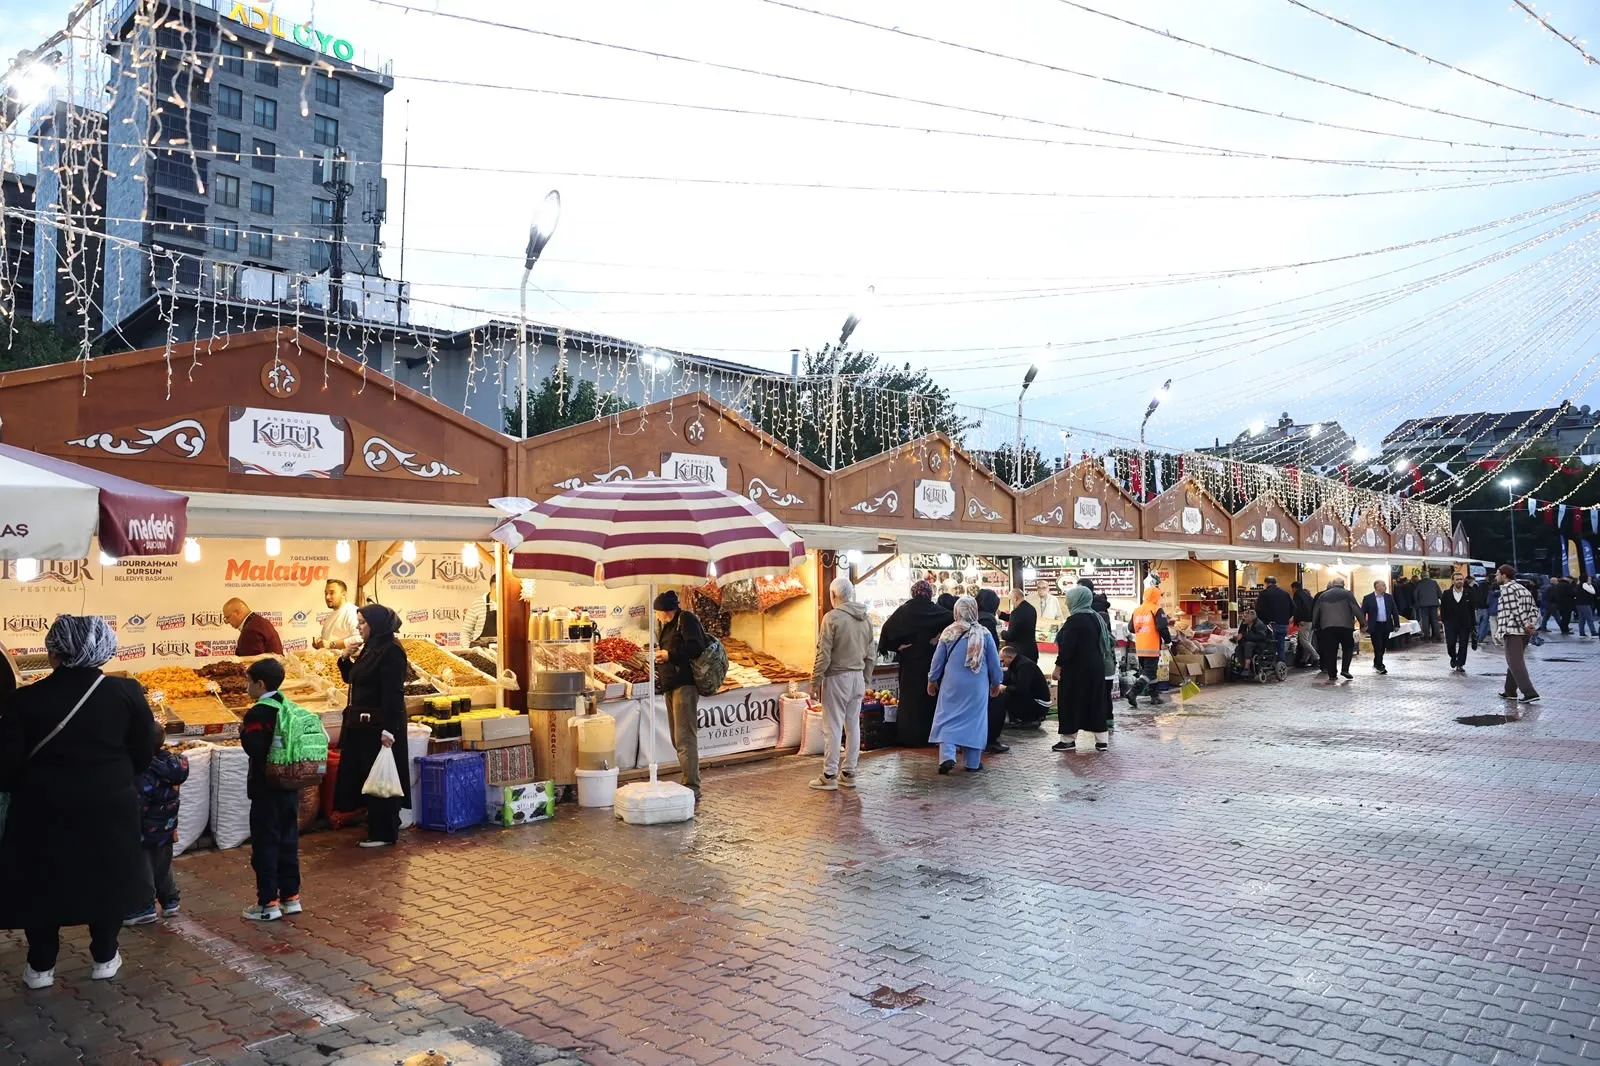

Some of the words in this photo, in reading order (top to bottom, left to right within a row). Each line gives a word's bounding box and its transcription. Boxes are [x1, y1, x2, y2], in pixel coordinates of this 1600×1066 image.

[293, 24, 353, 61] GYO
[252, 419, 324, 449] KÜLTÜR
[267, 416, 311, 424] ANADOLU
[225, 559, 330, 587] Malatya
[708, 725, 751, 740] YÖRESEL
